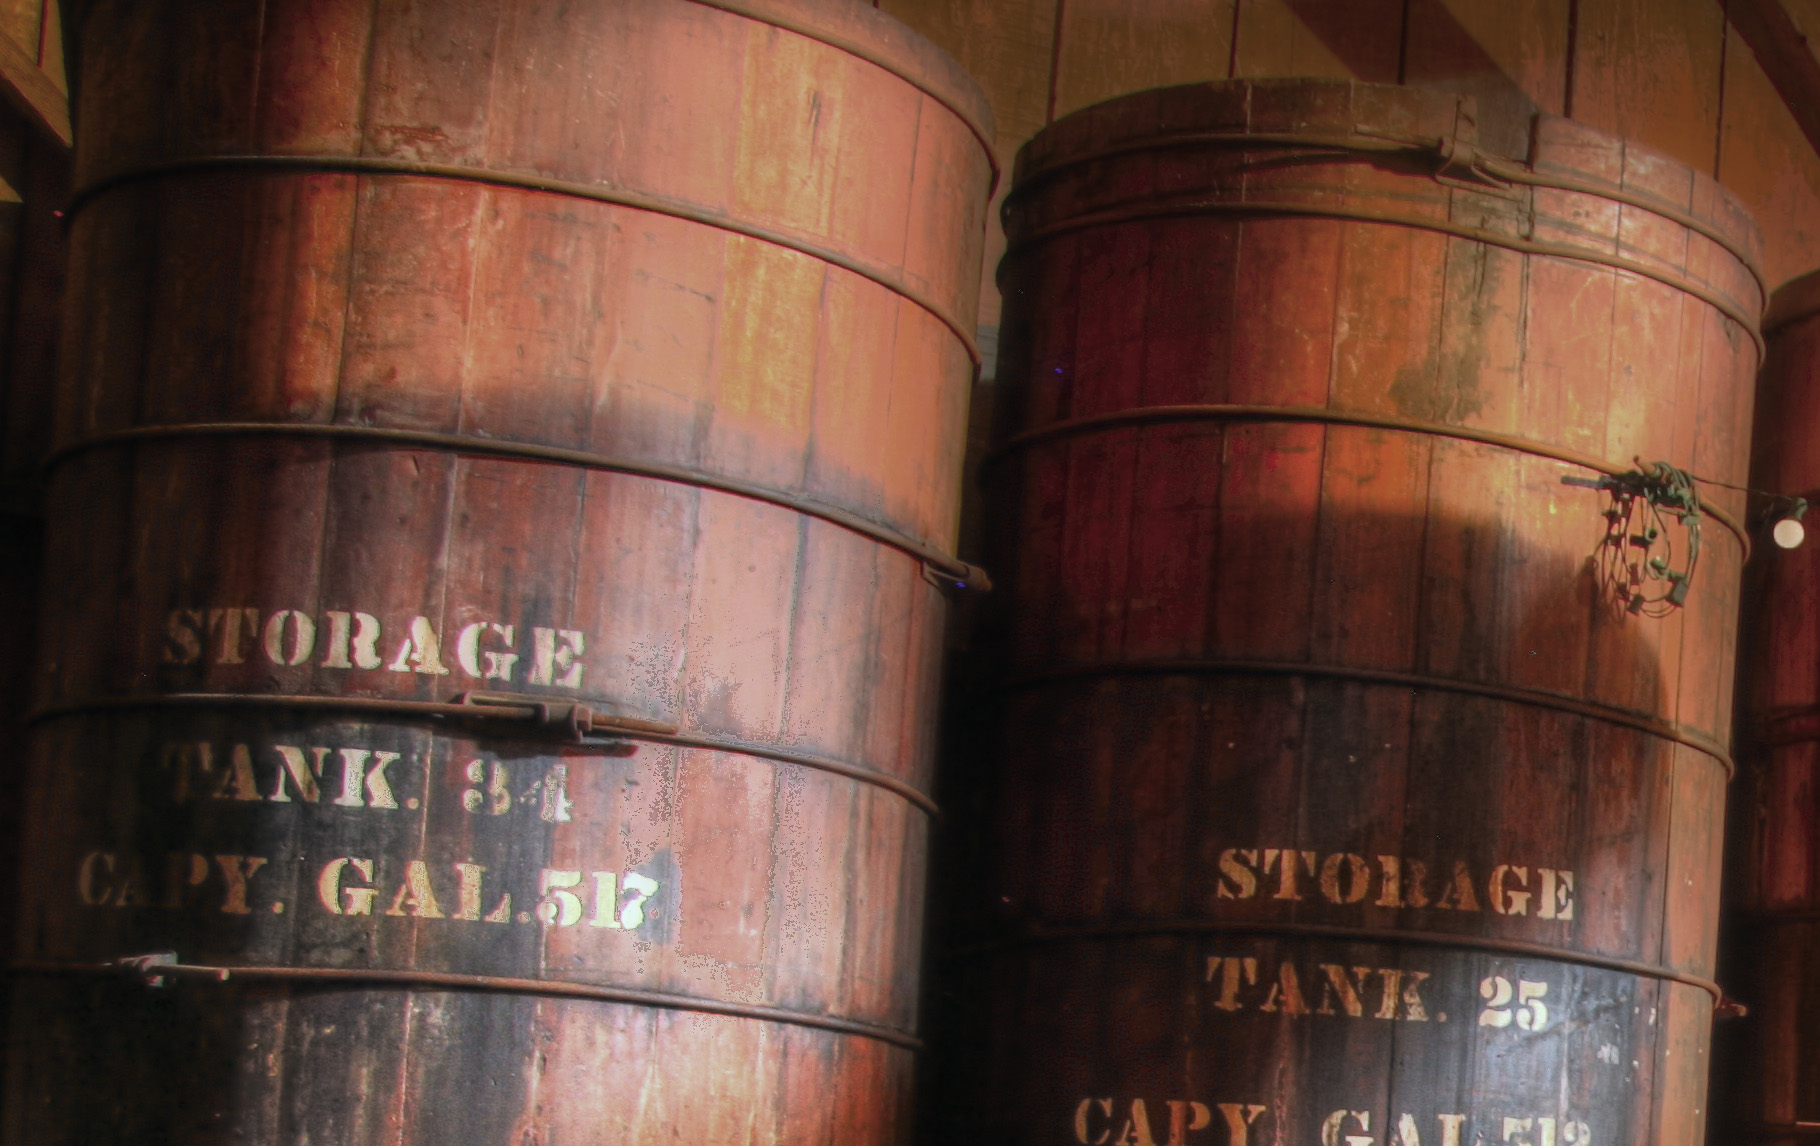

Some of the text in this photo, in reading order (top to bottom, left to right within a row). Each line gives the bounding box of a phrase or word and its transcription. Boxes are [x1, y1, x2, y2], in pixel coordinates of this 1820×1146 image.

[162, 607, 587, 689] STORAGE
[1216, 848, 1575, 921] STORAGE
[1478, 975, 1549, 1032] 25
